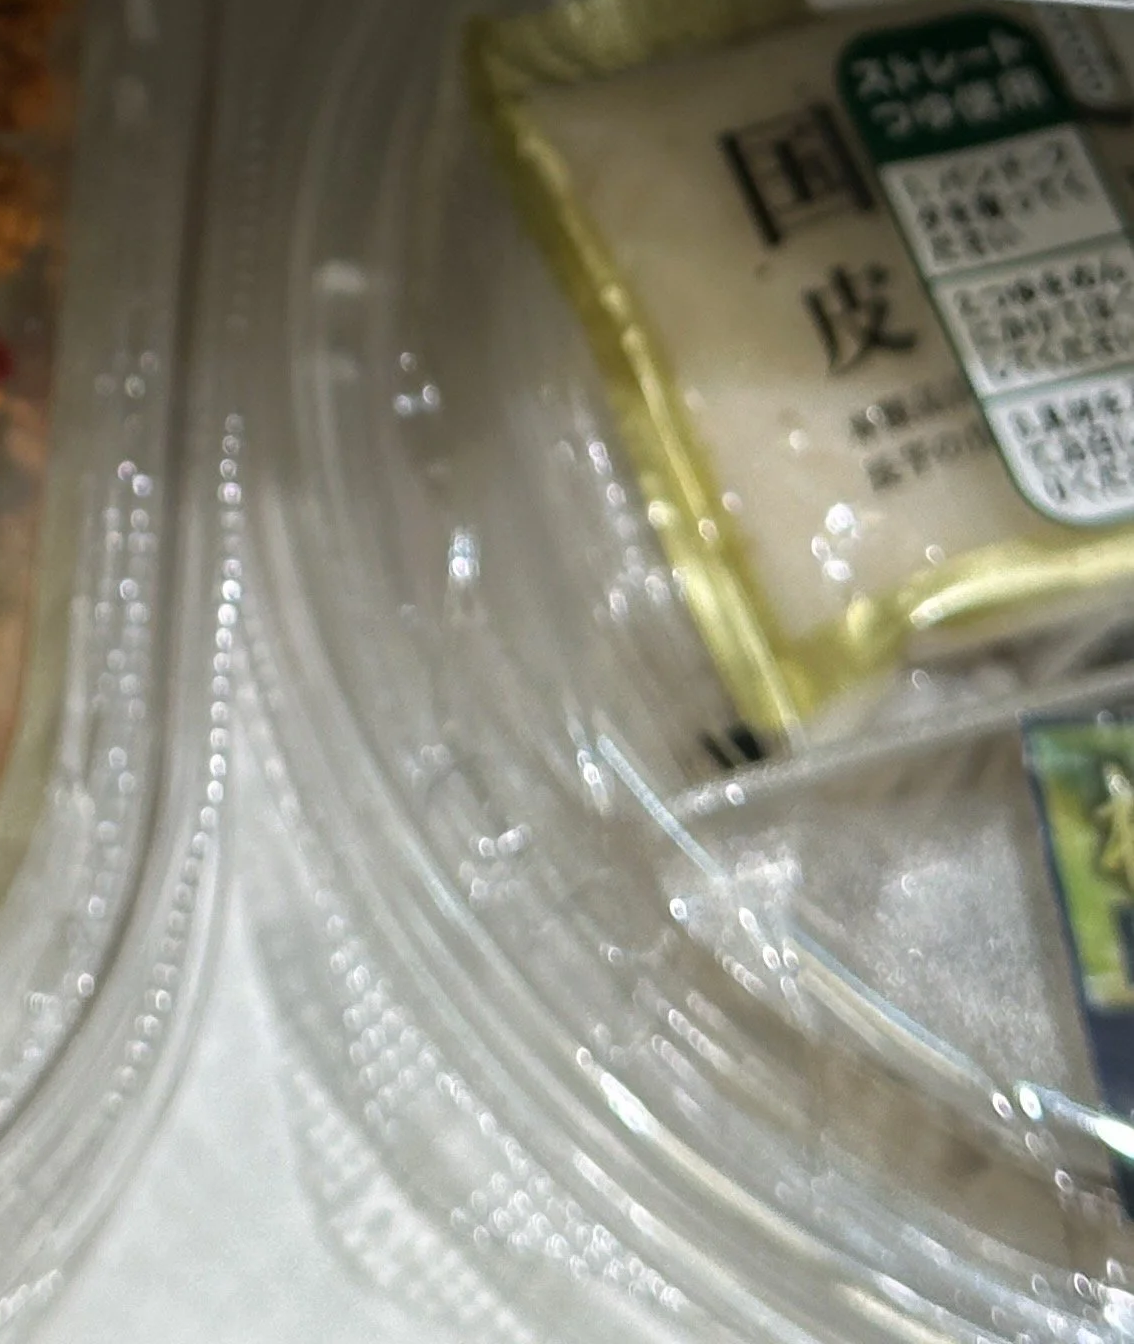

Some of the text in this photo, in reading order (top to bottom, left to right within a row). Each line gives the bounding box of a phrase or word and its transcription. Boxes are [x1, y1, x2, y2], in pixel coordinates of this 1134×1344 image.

[851, 28, 1025, 103] ストレート
